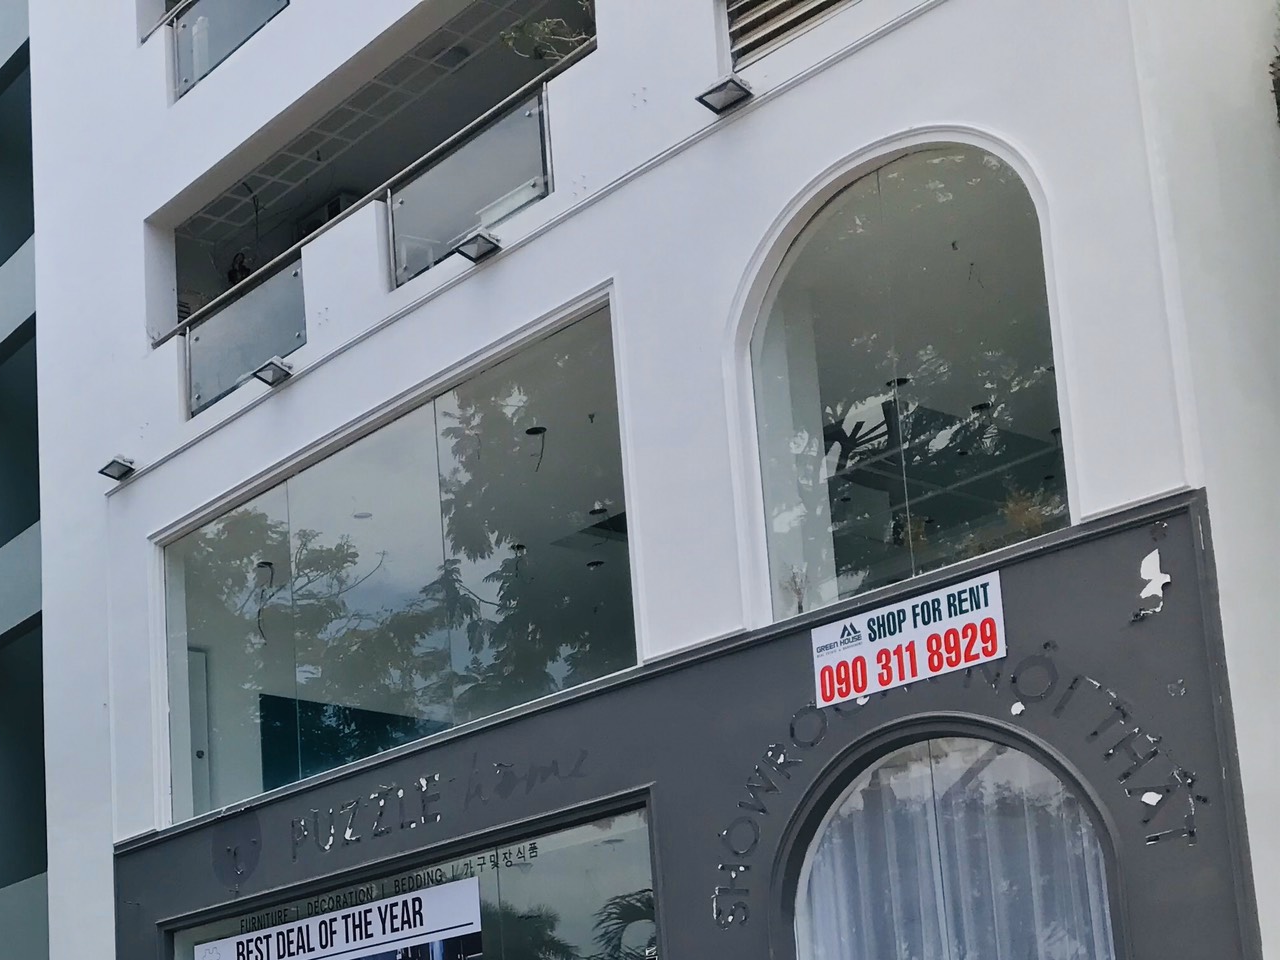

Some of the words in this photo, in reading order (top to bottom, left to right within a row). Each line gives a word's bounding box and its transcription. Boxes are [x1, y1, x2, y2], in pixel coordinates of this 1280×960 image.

[839, 633, 863, 647] HOUSE
[867, 608, 906, 642] SHOP
[911, 597, 942, 629] FOR
[946, 582, 990, 618] RENT
[820, 655, 867, 703] 090
[876, 640, 918, 687] 311
[926, 617, 998, 672] 8929
[290, 772, 442, 863] PUZZLE
[463, 842, 538, 877] 가구및장식품
[240, 908, 288, 935] FURNITURE
[307, 883, 374, 915] DECORATION
[394, 868, 443, 894] BEDDING
[276, 923, 315, 960] DEAL
[319, 917, 338, 949] OF
[341, 908, 374, 944] THE
[377, 896, 424, 936] YEAR
